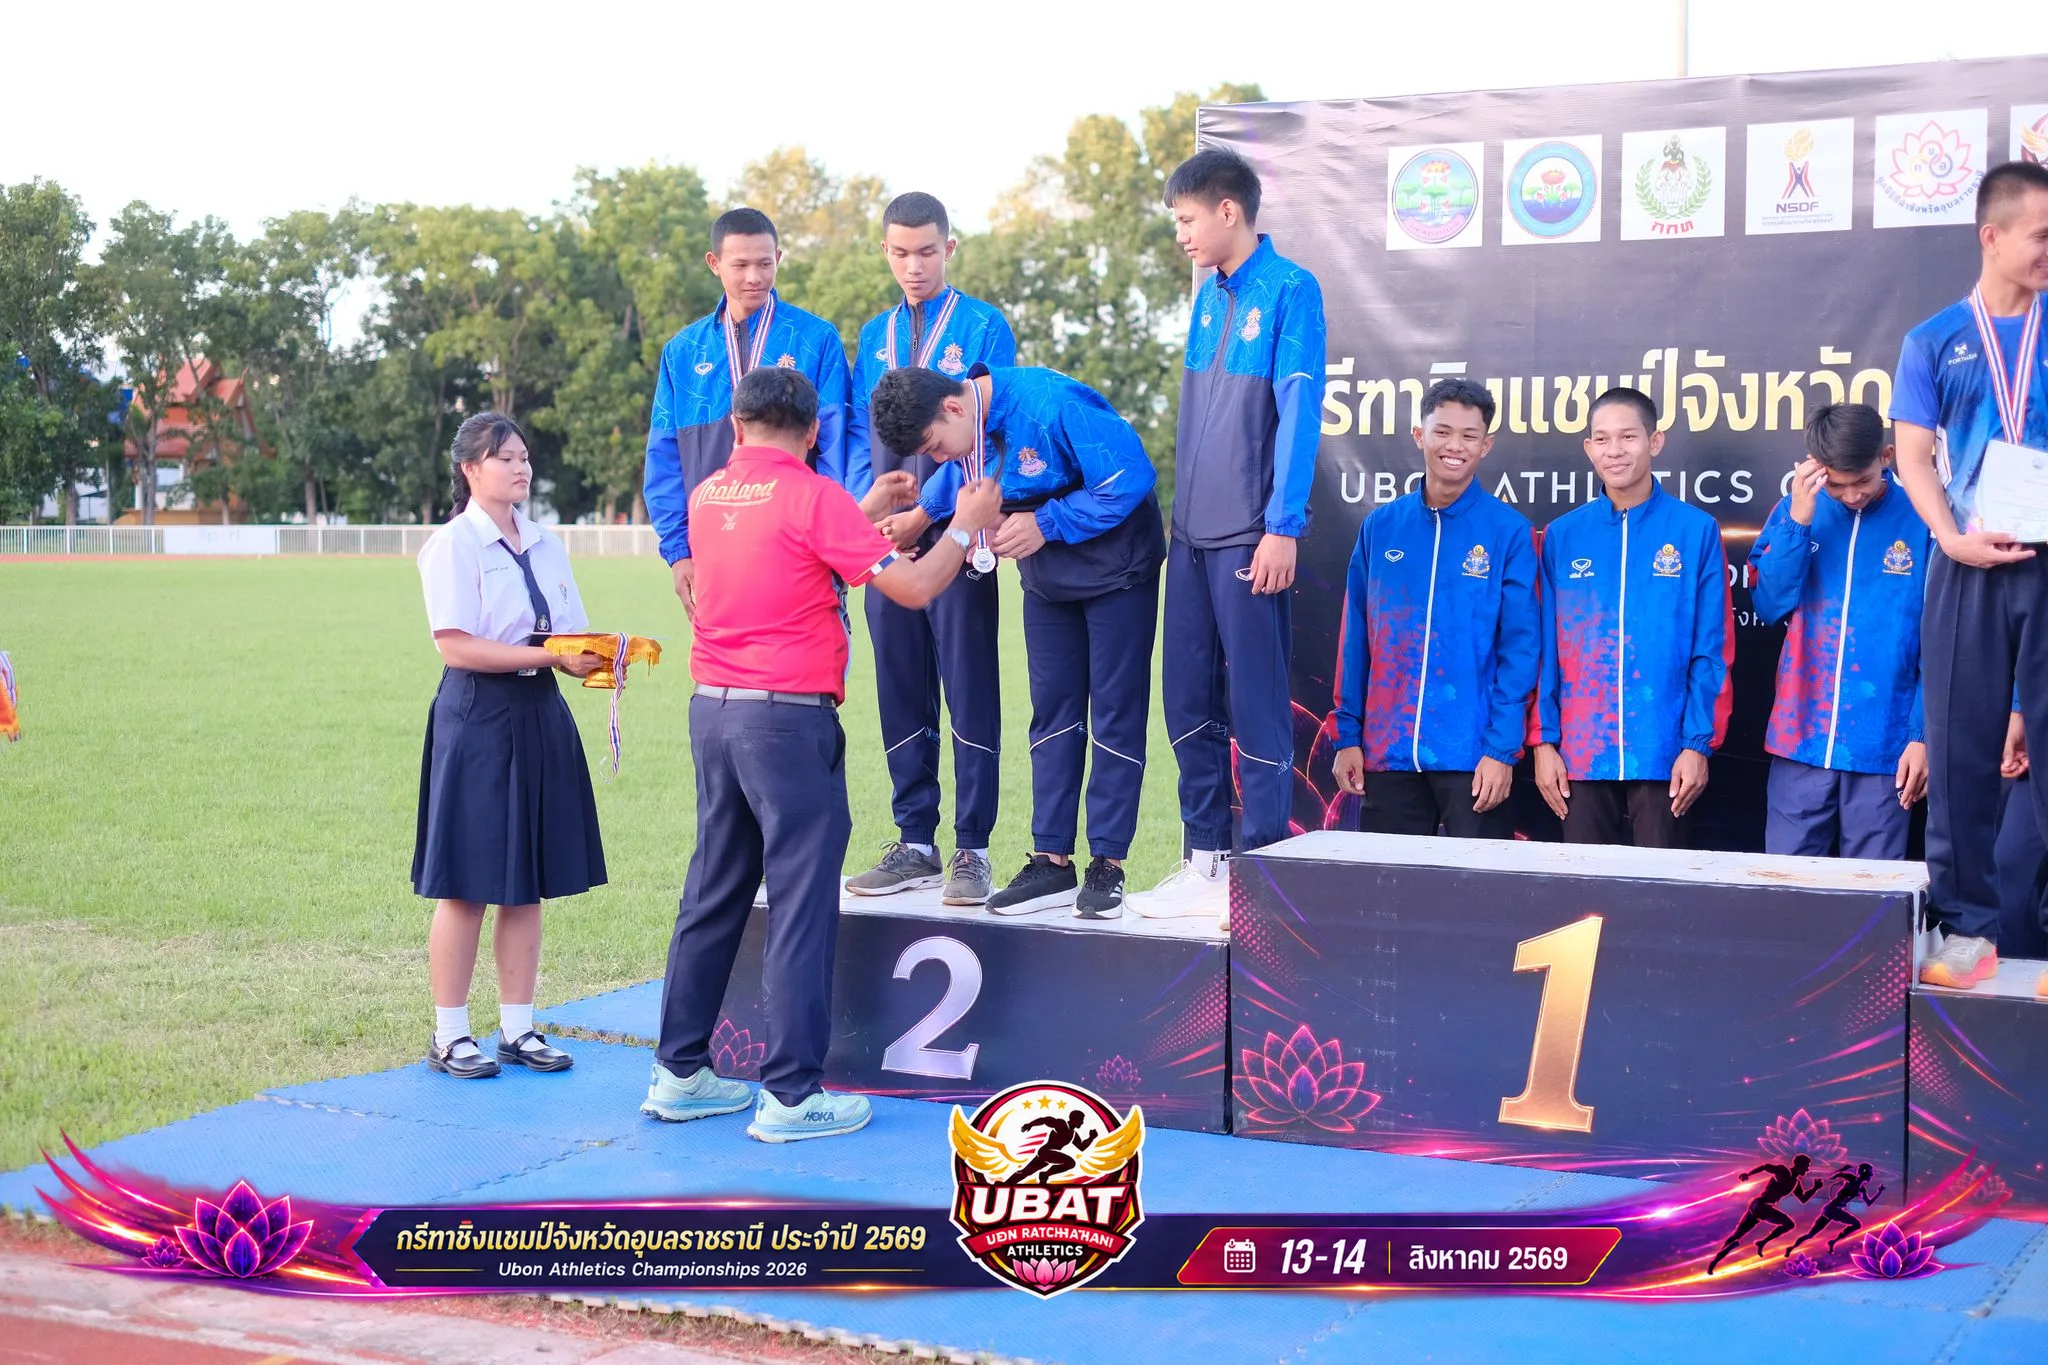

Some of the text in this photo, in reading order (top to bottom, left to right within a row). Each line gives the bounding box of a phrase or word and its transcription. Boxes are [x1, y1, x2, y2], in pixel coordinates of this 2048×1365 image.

[1776, 201, 1820, 214] NSDF
[1651, 220, 1694, 235] กกท
[695, 470, 779, 510] Thailand
[1494, 470, 1753, 504] ATHLTICS
[881, 935, 983, 1081] 2
[1498, 915, 1604, 1133] 1
[803, 1111, 835, 1122] HOKA
